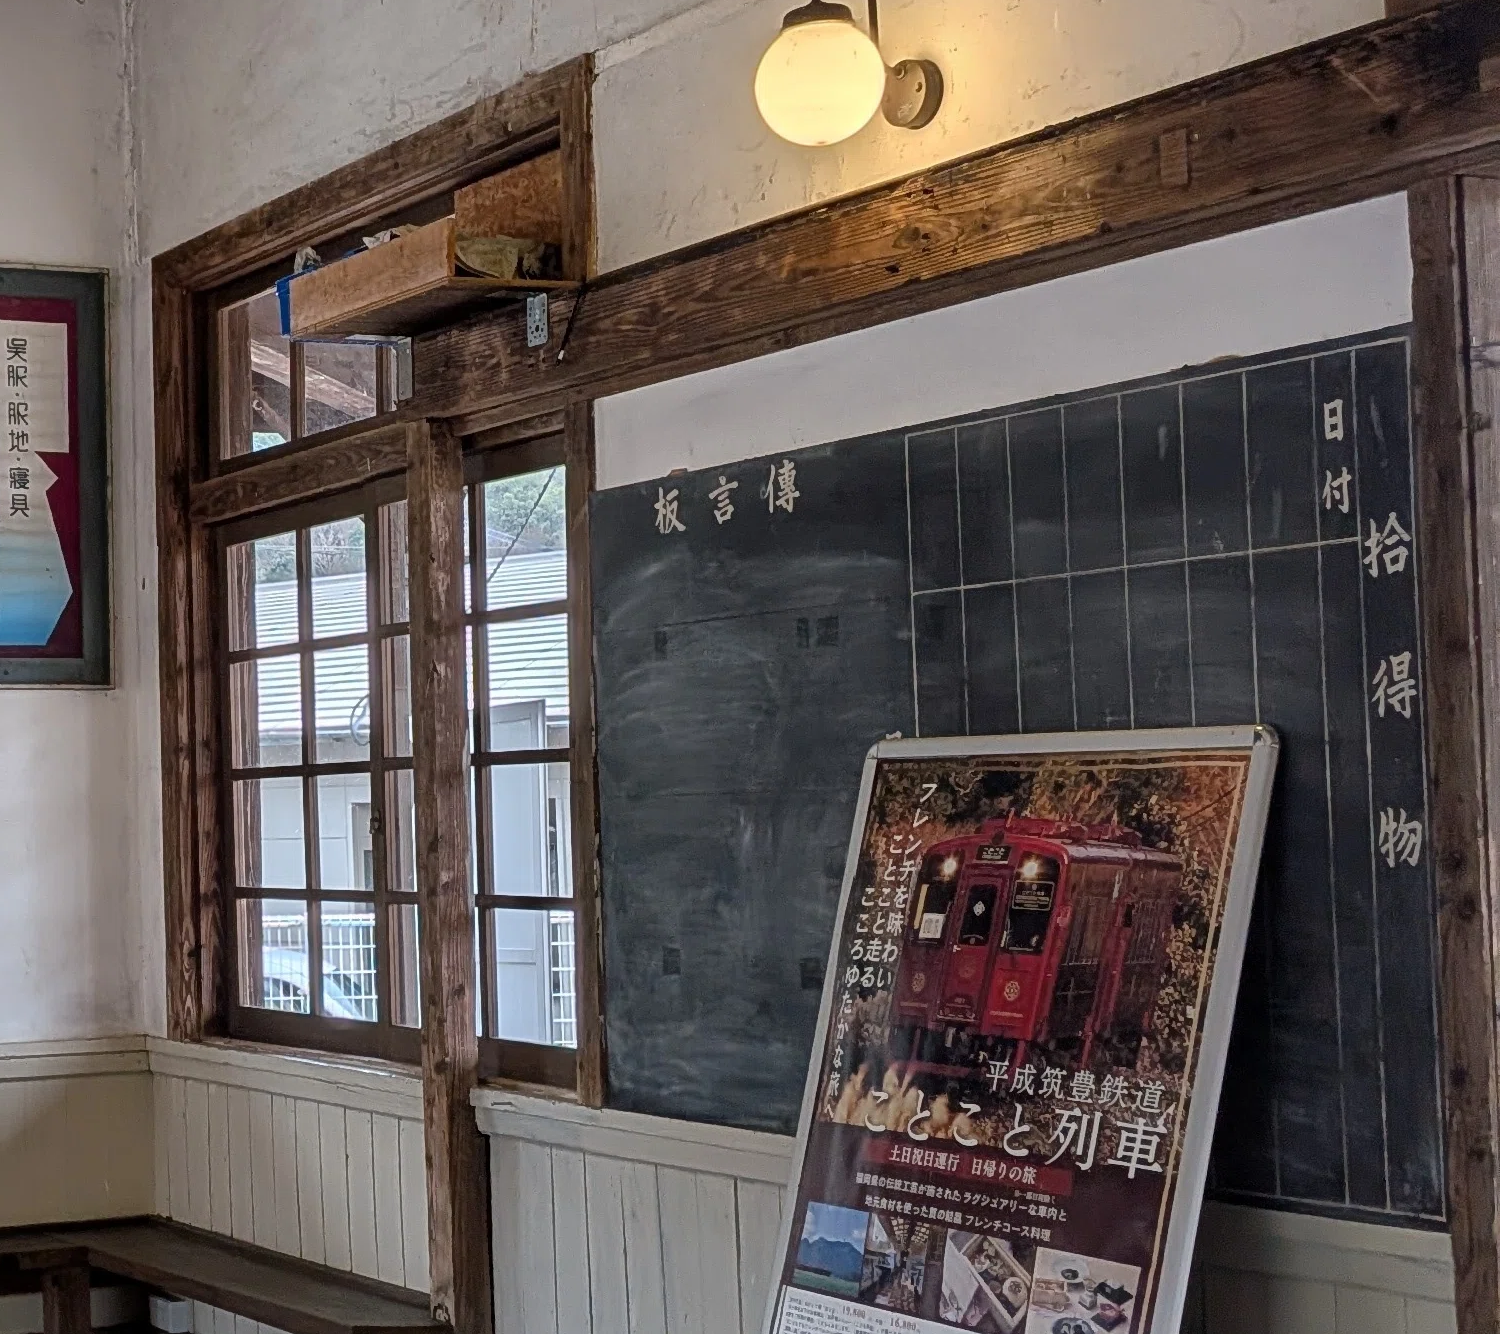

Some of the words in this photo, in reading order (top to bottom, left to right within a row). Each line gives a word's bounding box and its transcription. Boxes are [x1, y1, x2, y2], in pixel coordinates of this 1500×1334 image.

[6, 337, 30, 518] 呉服・服地・寝具
[1322, 398, 1353, 514] 日付
[1363, 511, 1423, 868] 拾得物
[869, 834, 905, 988] ことこと走る
[877, 783, 938, 987] フレンチを味わい
[824, 887, 876, 1119] こころゆたかな旅へ
[864, 1089, 1169, 1180] ことこと列車
[986, 1059, 1167, 1114] 平成筑豊鉄道
[888, 1146, 961, 1173] 土日祝日運行
[970, 1157, 1038, 1186] 日帰りの旅
